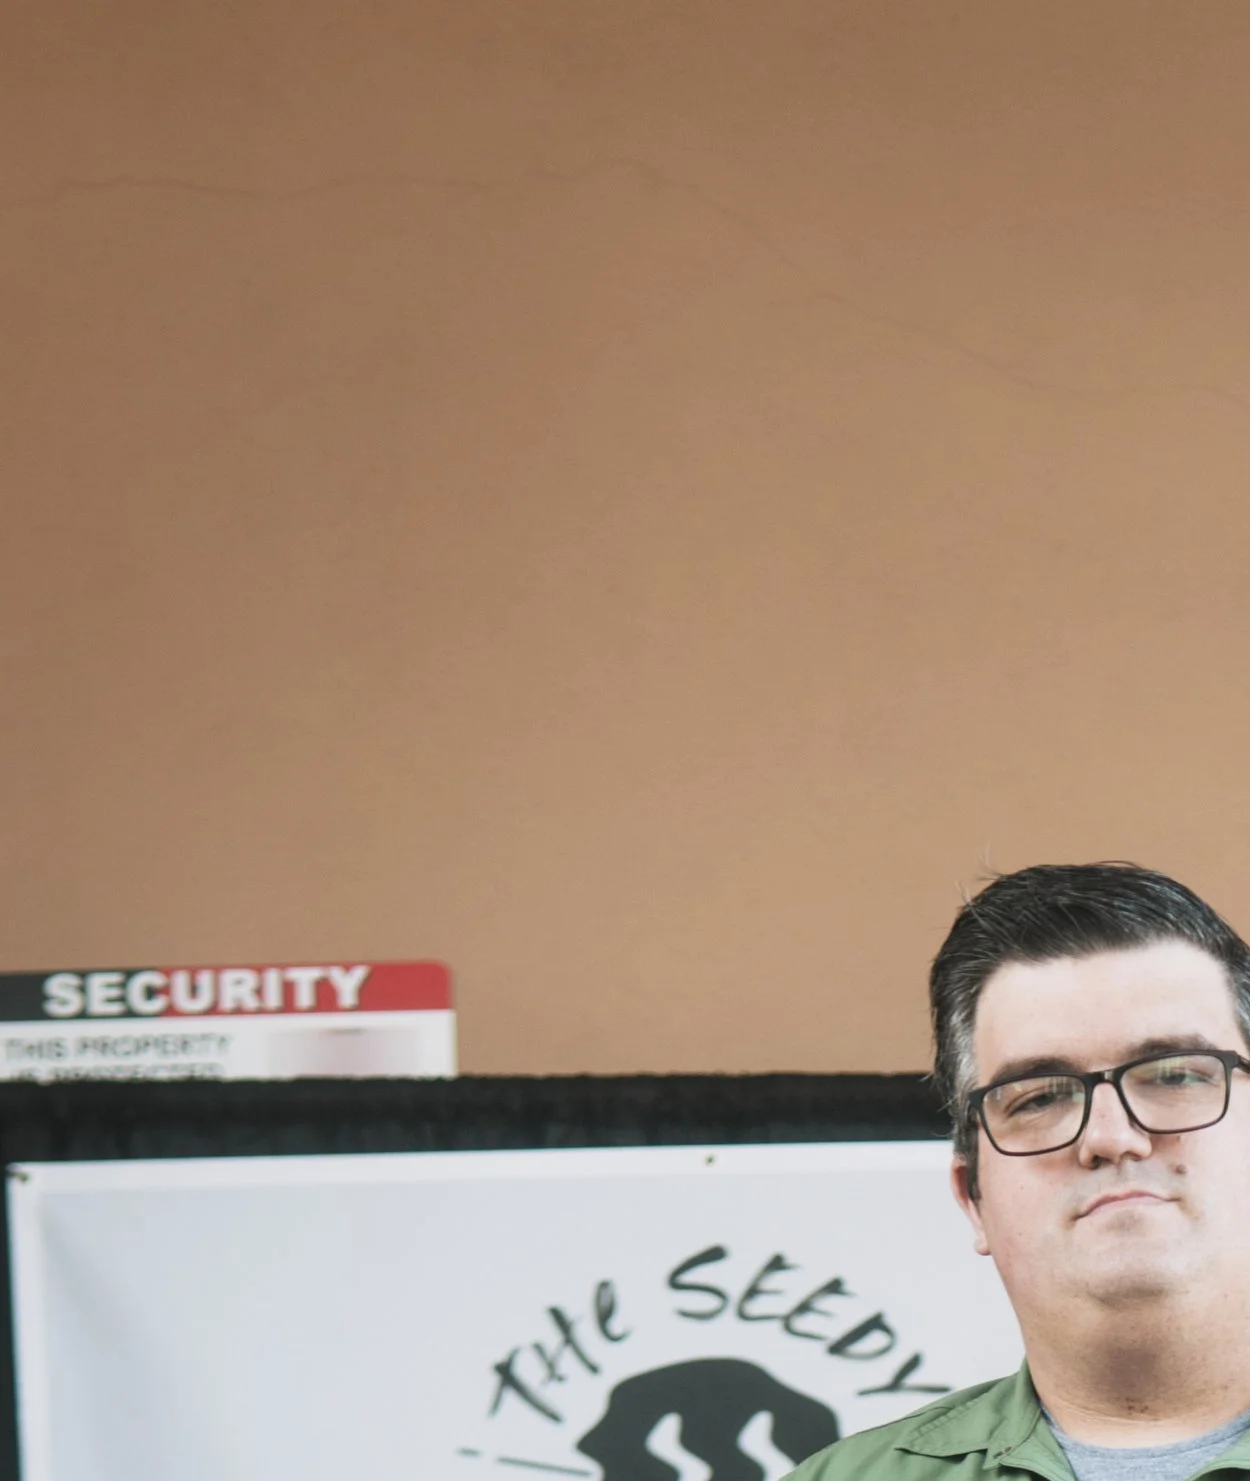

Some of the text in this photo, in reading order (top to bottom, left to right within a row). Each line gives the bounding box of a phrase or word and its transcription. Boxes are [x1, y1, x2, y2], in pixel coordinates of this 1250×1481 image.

[43, 965, 371, 1017] SECURITY
[4, 1032, 231, 1061] THIS PROPERTY
[667, 1243, 953, 1400] SEEDY
